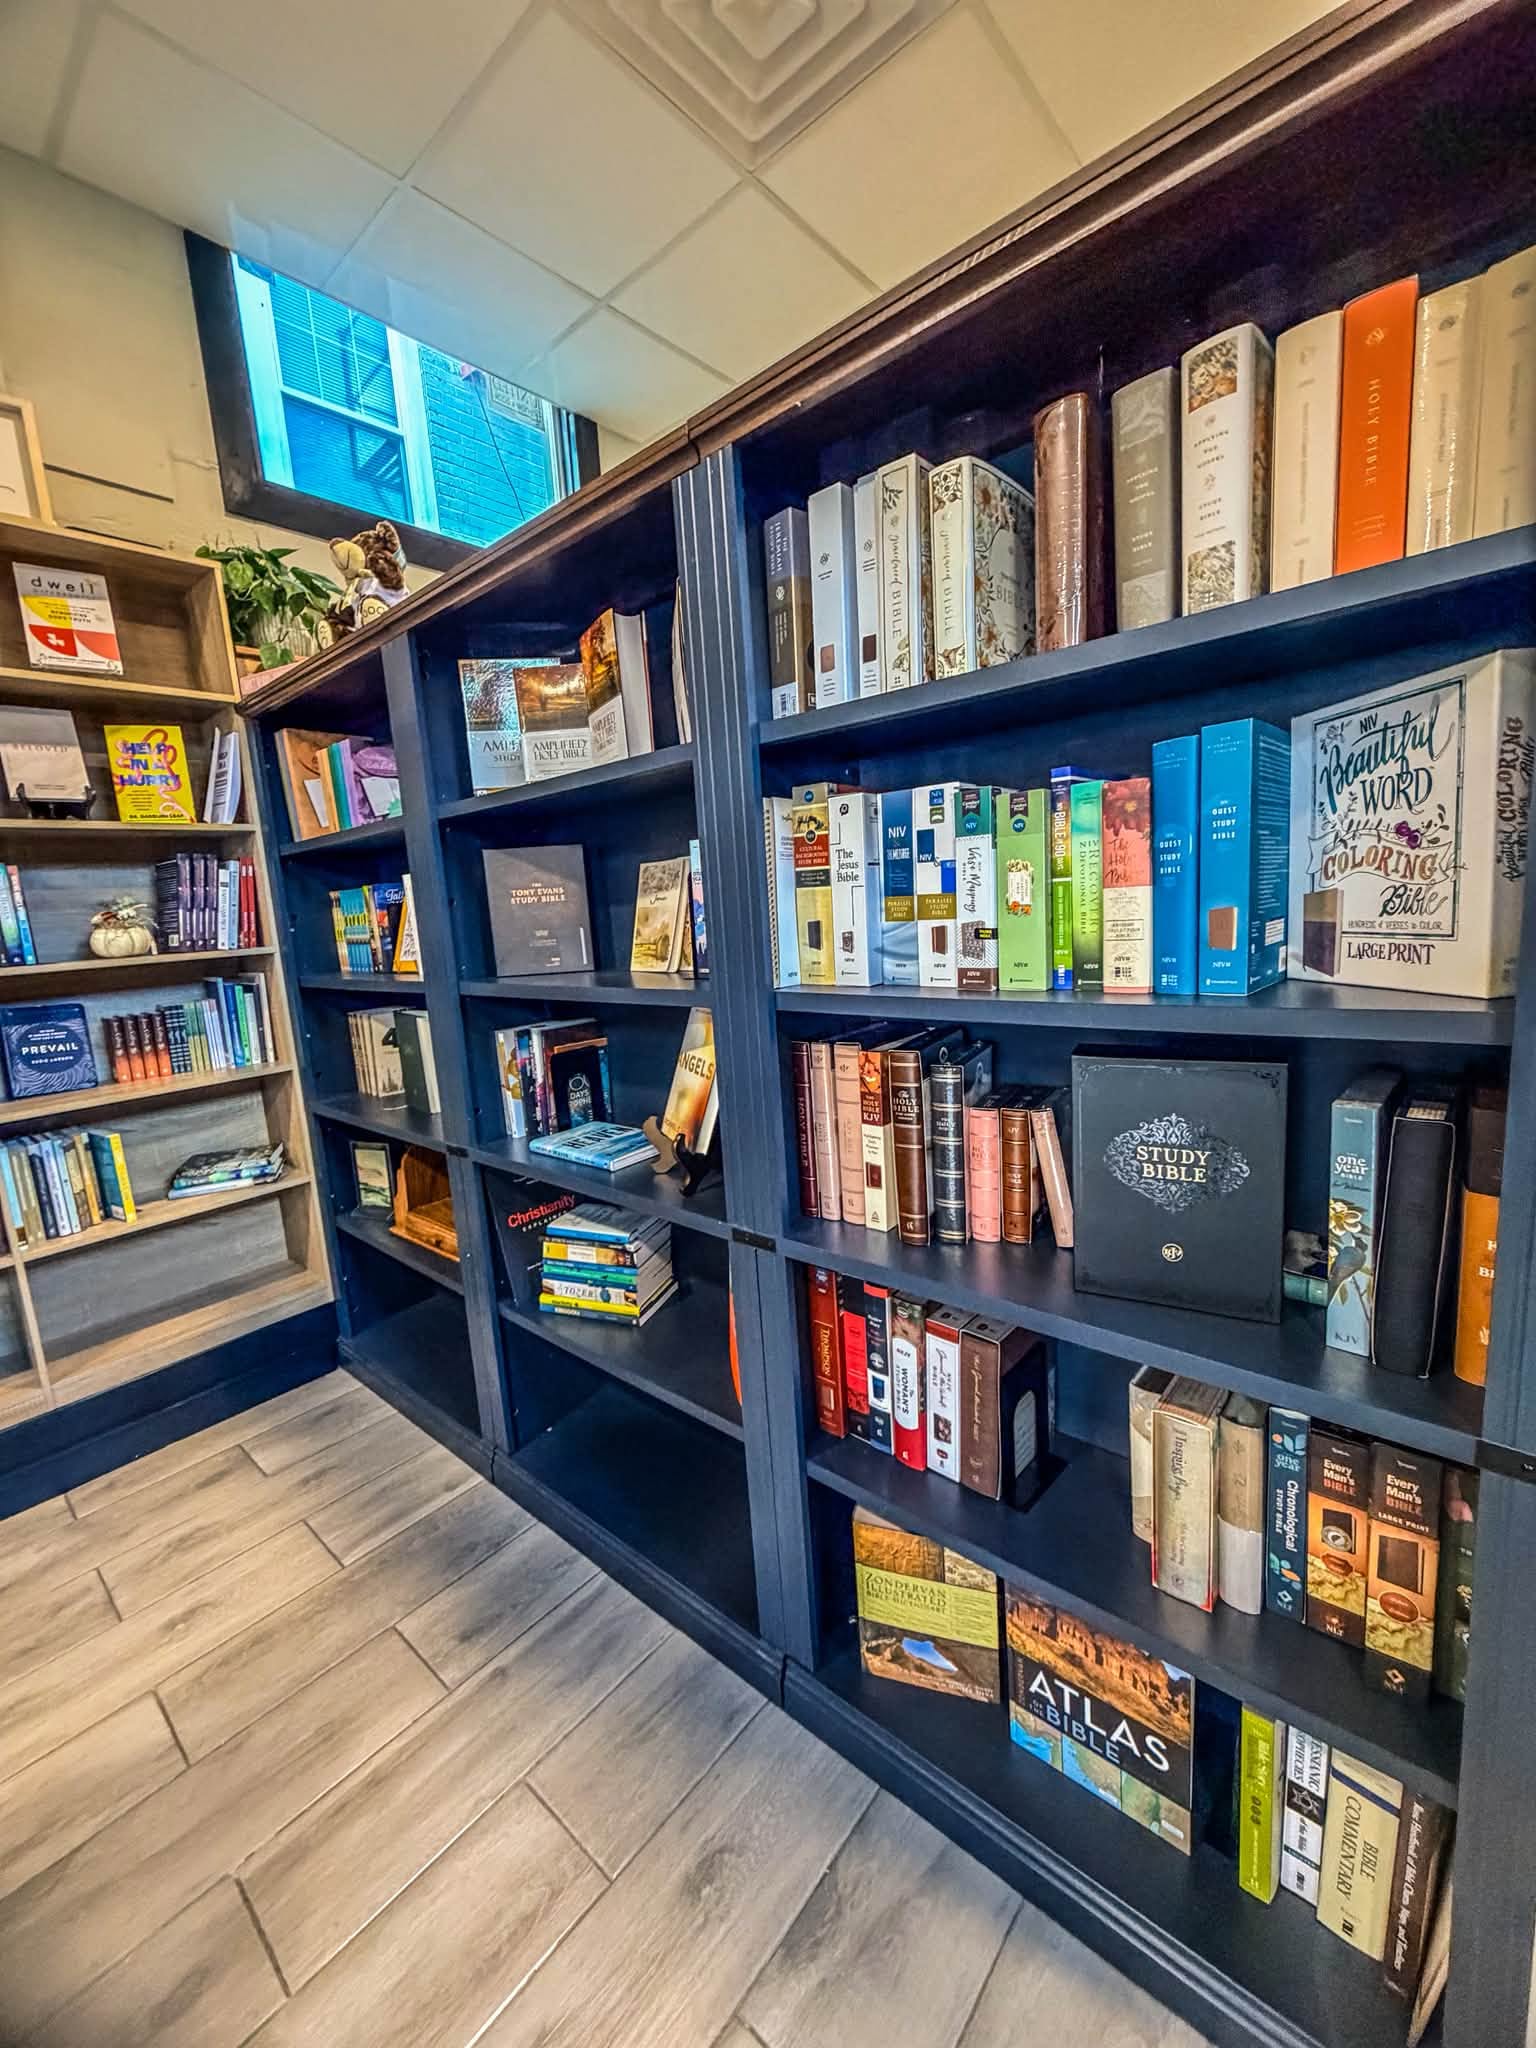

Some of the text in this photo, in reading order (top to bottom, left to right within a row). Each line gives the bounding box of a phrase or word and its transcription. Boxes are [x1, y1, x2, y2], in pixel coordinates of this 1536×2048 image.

[1363, 377, 1381, 488] HOLY BIBLE
[30, 575, 95, 595] dwell
[890, 593, 903, 639] BIBLE
[943, 588, 955, 638] BIBLE
[1360, 712, 1379, 735] NIV
[121, 742, 168, 755] HEP
[532, 738, 588, 752] AMPLIFIED
[1319, 692, 1456, 814] Beautiful
[533, 748, 587, 762] HOLY BIBLE
[1496, 716, 1524, 823] COLORING
[118, 774, 180, 787] HURRY
[1360, 765, 1433, 816] WORD
[1211, 805, 1237, 816] QUEST
[1054, 811, 1066, 838] BIBLE
[1211, 818, 1237, 828] STUDY
[888, 826, 906, 840] NIV
[1211, 831, 1236, 841] BIBLE
[835, 848, 854, 859] The
[1054, 843, 1066, 858] 90
[1108, 838, 1129, 850] The
[1159, 839, 1182, 849] QUEST
[836, 858, 860, 873] Jesus
[919, 853, 933, 862] NIV
[966, 846, 981, 873] Verse
[1159, 852, 1182, 862] STUDY
[1323, 845, 1439, 884] COLORING
[836, 870, 860, 883] Bible
[1159, 864, 1182, 875] BIBLE
[510, 894, 565, 905] STUDY BIBLE
[511, 886, 564, 898] TONY EVANS
[1089, 848, 1098, 936] RECOVERY
[1378, 882, 1448, 917] Bible
[1419, 920, 1443, 932] COLOR
[1347, 941, 1436, 966] LARGE PRINT
[21, 1042, 79, 1056] PREVAIL
[677, 1051, 715, 1082] ANGELS
[570, 1089, 590, 1100] DAYS
[893, 1097, 917, 1106] HOLY
[863, 1112, 880, 1122] KJV
[893, 1105, 920, 1113] BIBLE
[561, 1126, 634, 1149] HEAVEN
[797, 1096, 809, 1167] HOLY BIBLE
[1136, 1145, 1211, 1166] STUDY
[1336, 1155, 1367, 1167] one
[1142, 1163, 1208, 1184] BIBLE
[1333, 1163, 1369, 1176] year
[507, 1194, 576, 1228] Christianity
[1333, 1332, 1361, 1346] KJV
[820, 1327, 832, 1377] THOMPSON
[900, 1367, 911, 1415] WOMAN'S
[1273, 1459, 1301, 1472] year
[1277, 1453, 1299, 1465] one
[1323, 1458, 1353, 1476] Every
[1323, 1469, 1356, 1487] Man's
[1386, 1474, 1420, 1494] Every
[1323, 1479, 1356, 1497] BIBLE
[1386, 1486, 1423, 1505] Man's
[1285, 1479, 1299, 1553] Chronological
[1386, 1496, 1423, 1517] BIBLE
[1274, 1510, 1282, 1534] BIBLE
[1378, 1511, 1431, 1534] LARGE PRINT
[864, 1570, 947, 1600] ZONDERVAN
[865, 1580, 947, 1607] ILLUSTRATED
[1028, 1669, 1170, 1773] ATLAS
[1046, 1704, 1121, 1765] BIBLE
[1308, 1738, 1322, 1793] ESSIANIC
[1335, 1794, 1363, 1902] COMMENTARY
[1360, 1838, 1379, 1884] BIBLE
